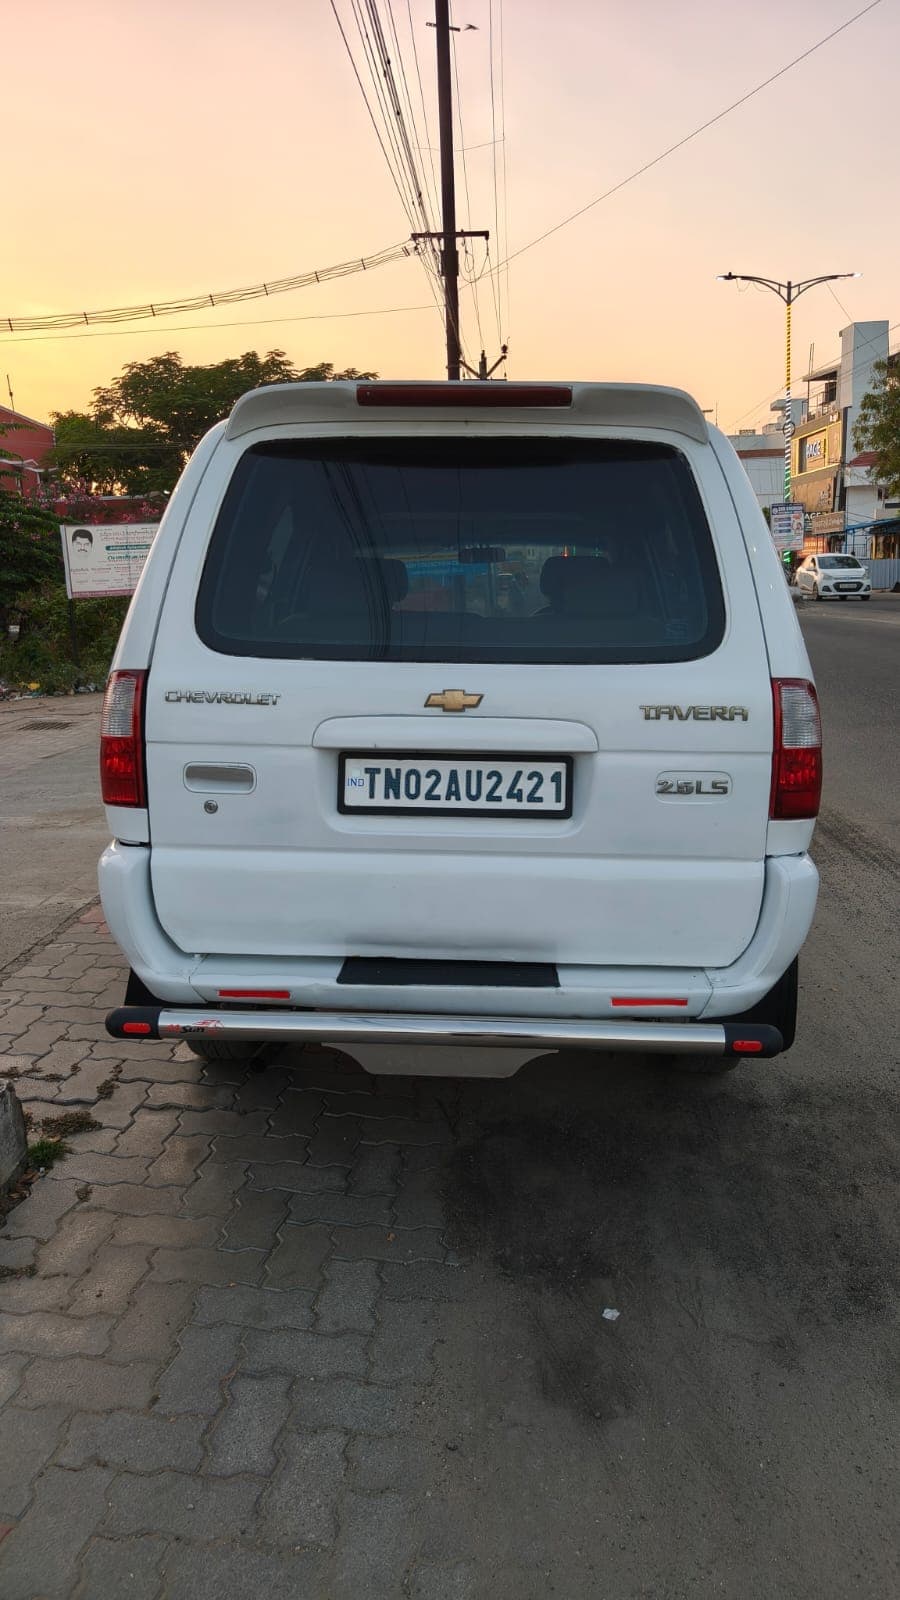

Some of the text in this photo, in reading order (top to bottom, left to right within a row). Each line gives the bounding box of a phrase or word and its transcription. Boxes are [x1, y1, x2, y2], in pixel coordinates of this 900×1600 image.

[165, 690, 280, 706] CHEVROLET
[640, 705, 749, 721] TAVERA
[347, 767, 562, 804] IND TN02AU2421
